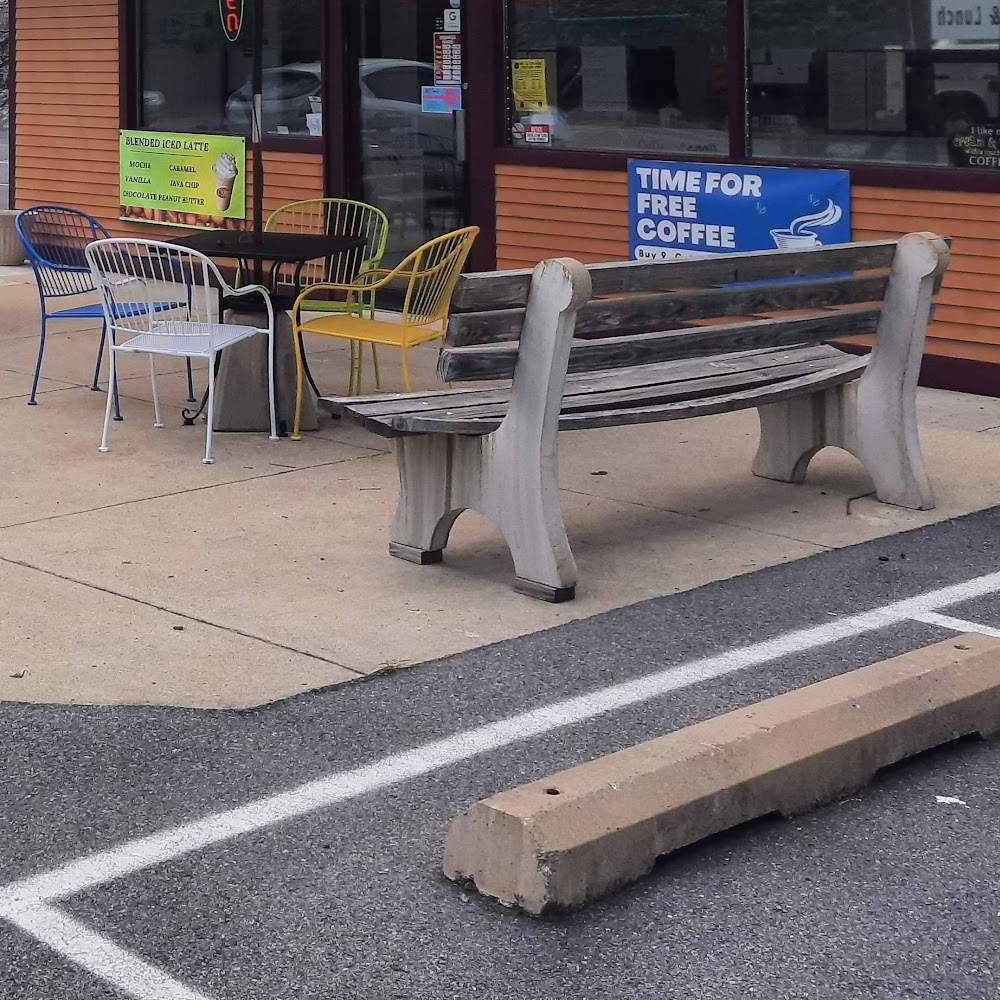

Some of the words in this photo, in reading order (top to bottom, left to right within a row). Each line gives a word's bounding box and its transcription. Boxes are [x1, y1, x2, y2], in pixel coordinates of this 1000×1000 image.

[125, 136, 160, 148] BLENDED
[162, 139, 181, 150] ICED
[183, 141, 209, 152] LATTE
[129, 160, 151, 169] MOCHA
[168, 164, 197, 173] CARAMEL
[125, 175, 151, 185] VANILLA
[169, 179, 184, 188] JAVA
[185, 181, 200, 189] CHIP
[635, 167, 702, 193] TIME
[704, 172, 762, 198] FOR
[123, 190, 157, 201] CHOCOLATE
[158, 194, 181, 203] PEANUT
[182, 197, 205, 206] BUTTER
[636, 192, 698, 219] FREE
[636, 217, 736, 249] COFFEE
[638, 249, 656, 260] Buy
